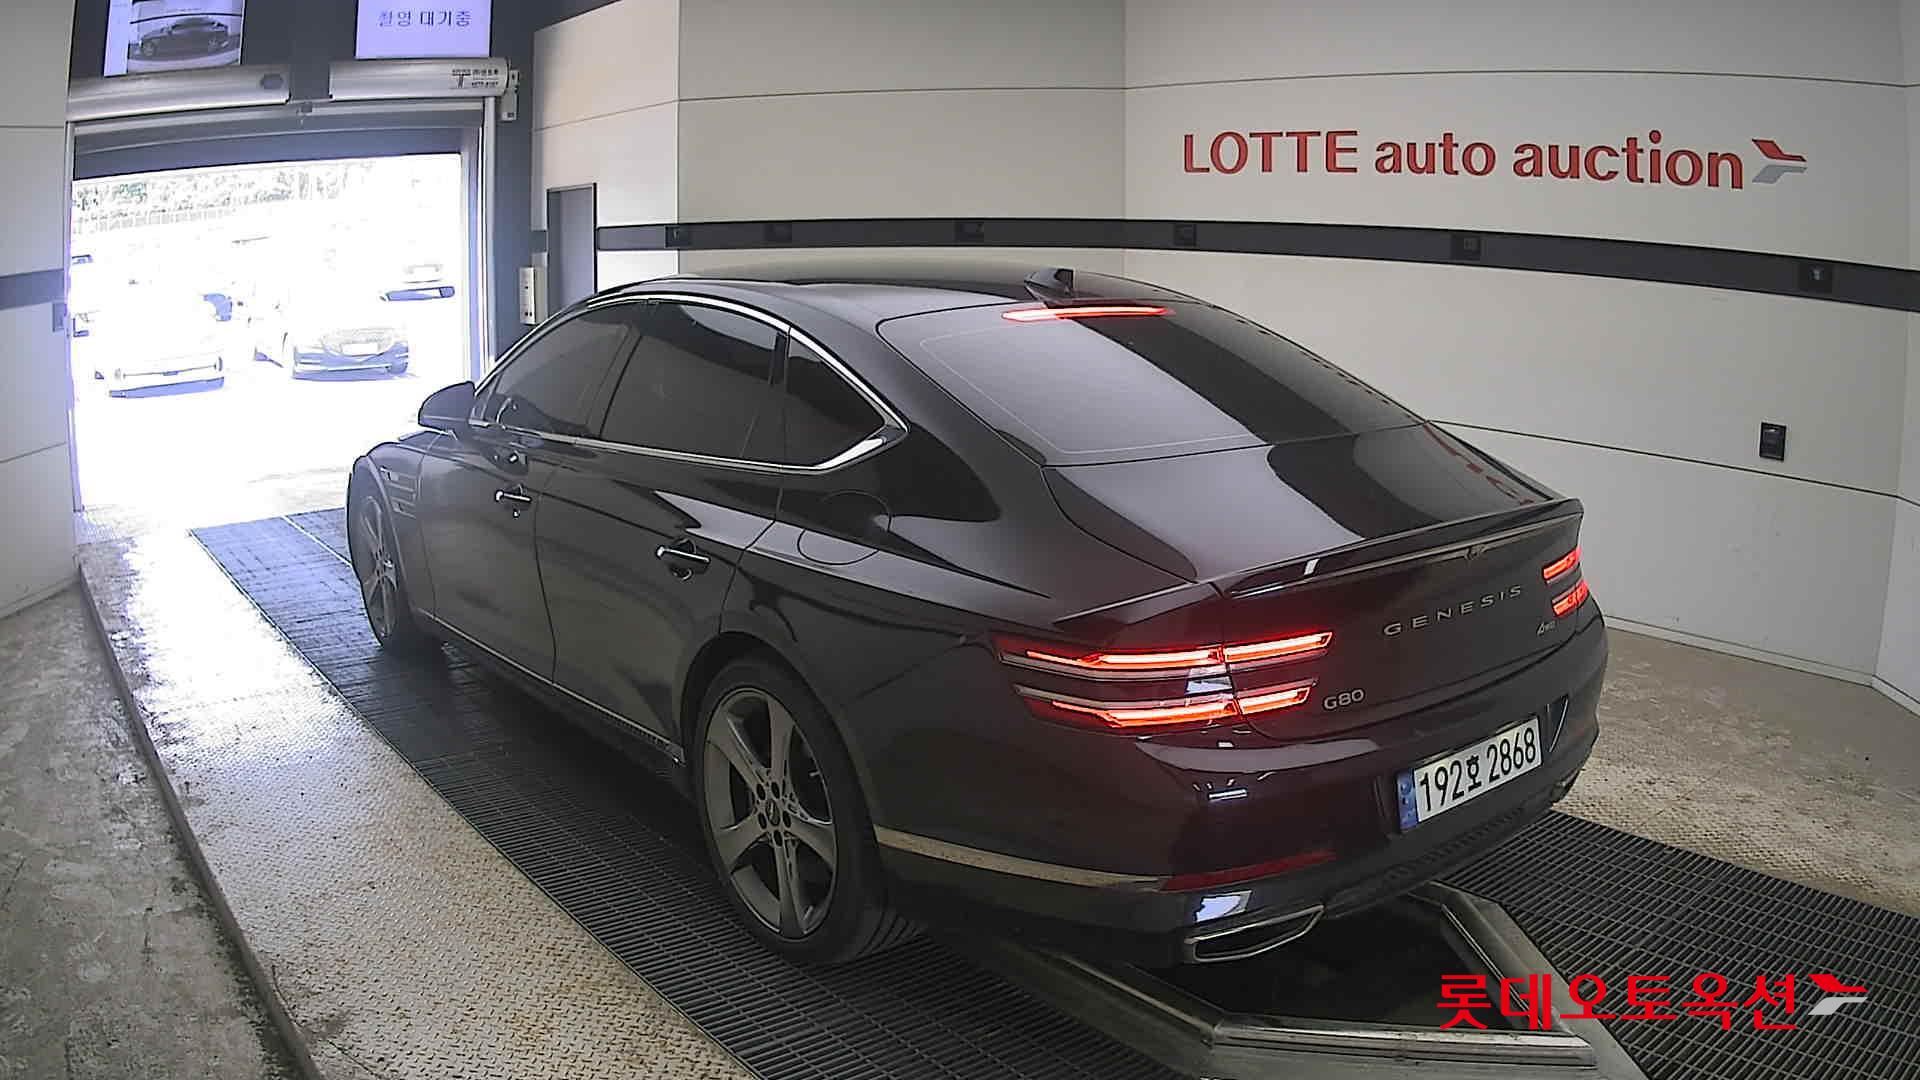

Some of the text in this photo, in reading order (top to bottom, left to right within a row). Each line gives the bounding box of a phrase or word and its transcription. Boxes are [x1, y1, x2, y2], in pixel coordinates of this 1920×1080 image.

[420, 10, 471, 27] 대기중
[1184, 130, 1744, 189] LOTTE auto auction
[1383, 585, 1522, 636] GENESIS
[1324, 689, 1365, 710] G80
[1419, 727, 1536, 812] 192호 2868
